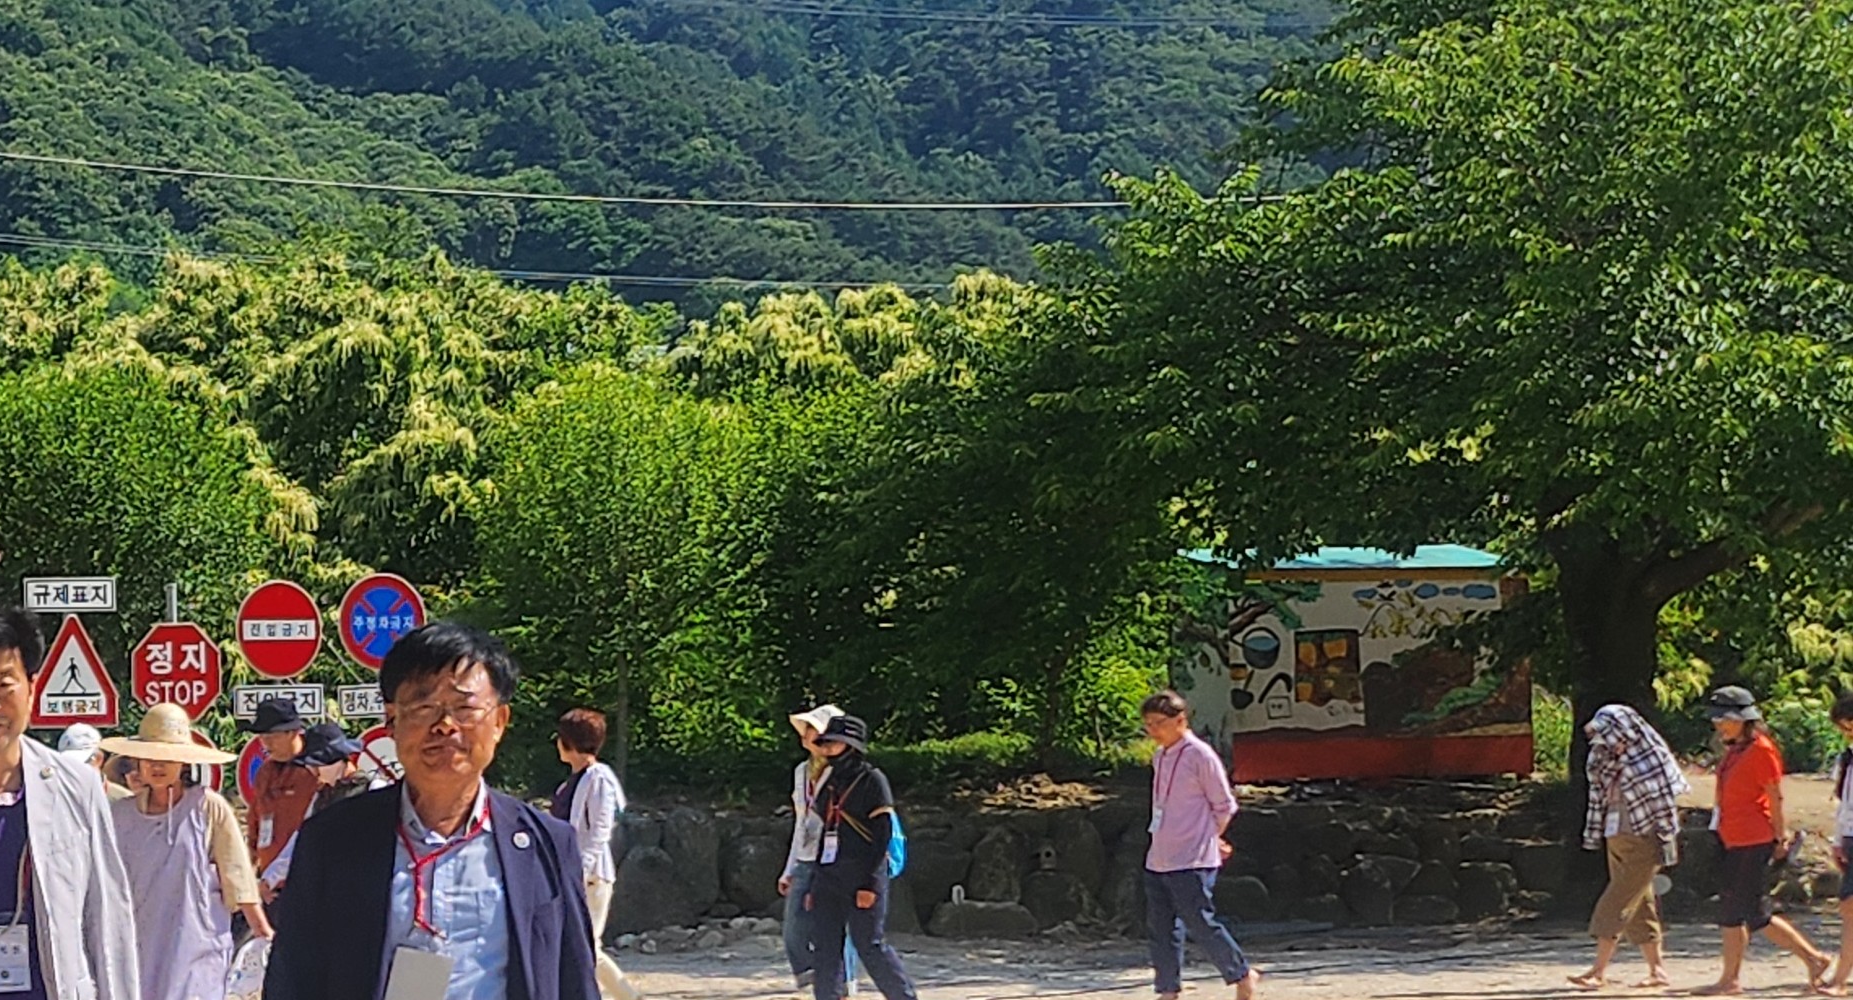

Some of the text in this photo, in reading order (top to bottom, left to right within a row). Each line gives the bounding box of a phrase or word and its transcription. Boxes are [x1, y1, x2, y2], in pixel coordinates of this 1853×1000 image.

[33, 583, 107, 605] 규제표지
[250, 623, 308, 637] 진입금지
[145, 641, 206, 675] 정지
[145, 680, 206, 705] STOP
[243, 690, 316, 712] 진지
[46, 700, 100, 713] 보행금지
